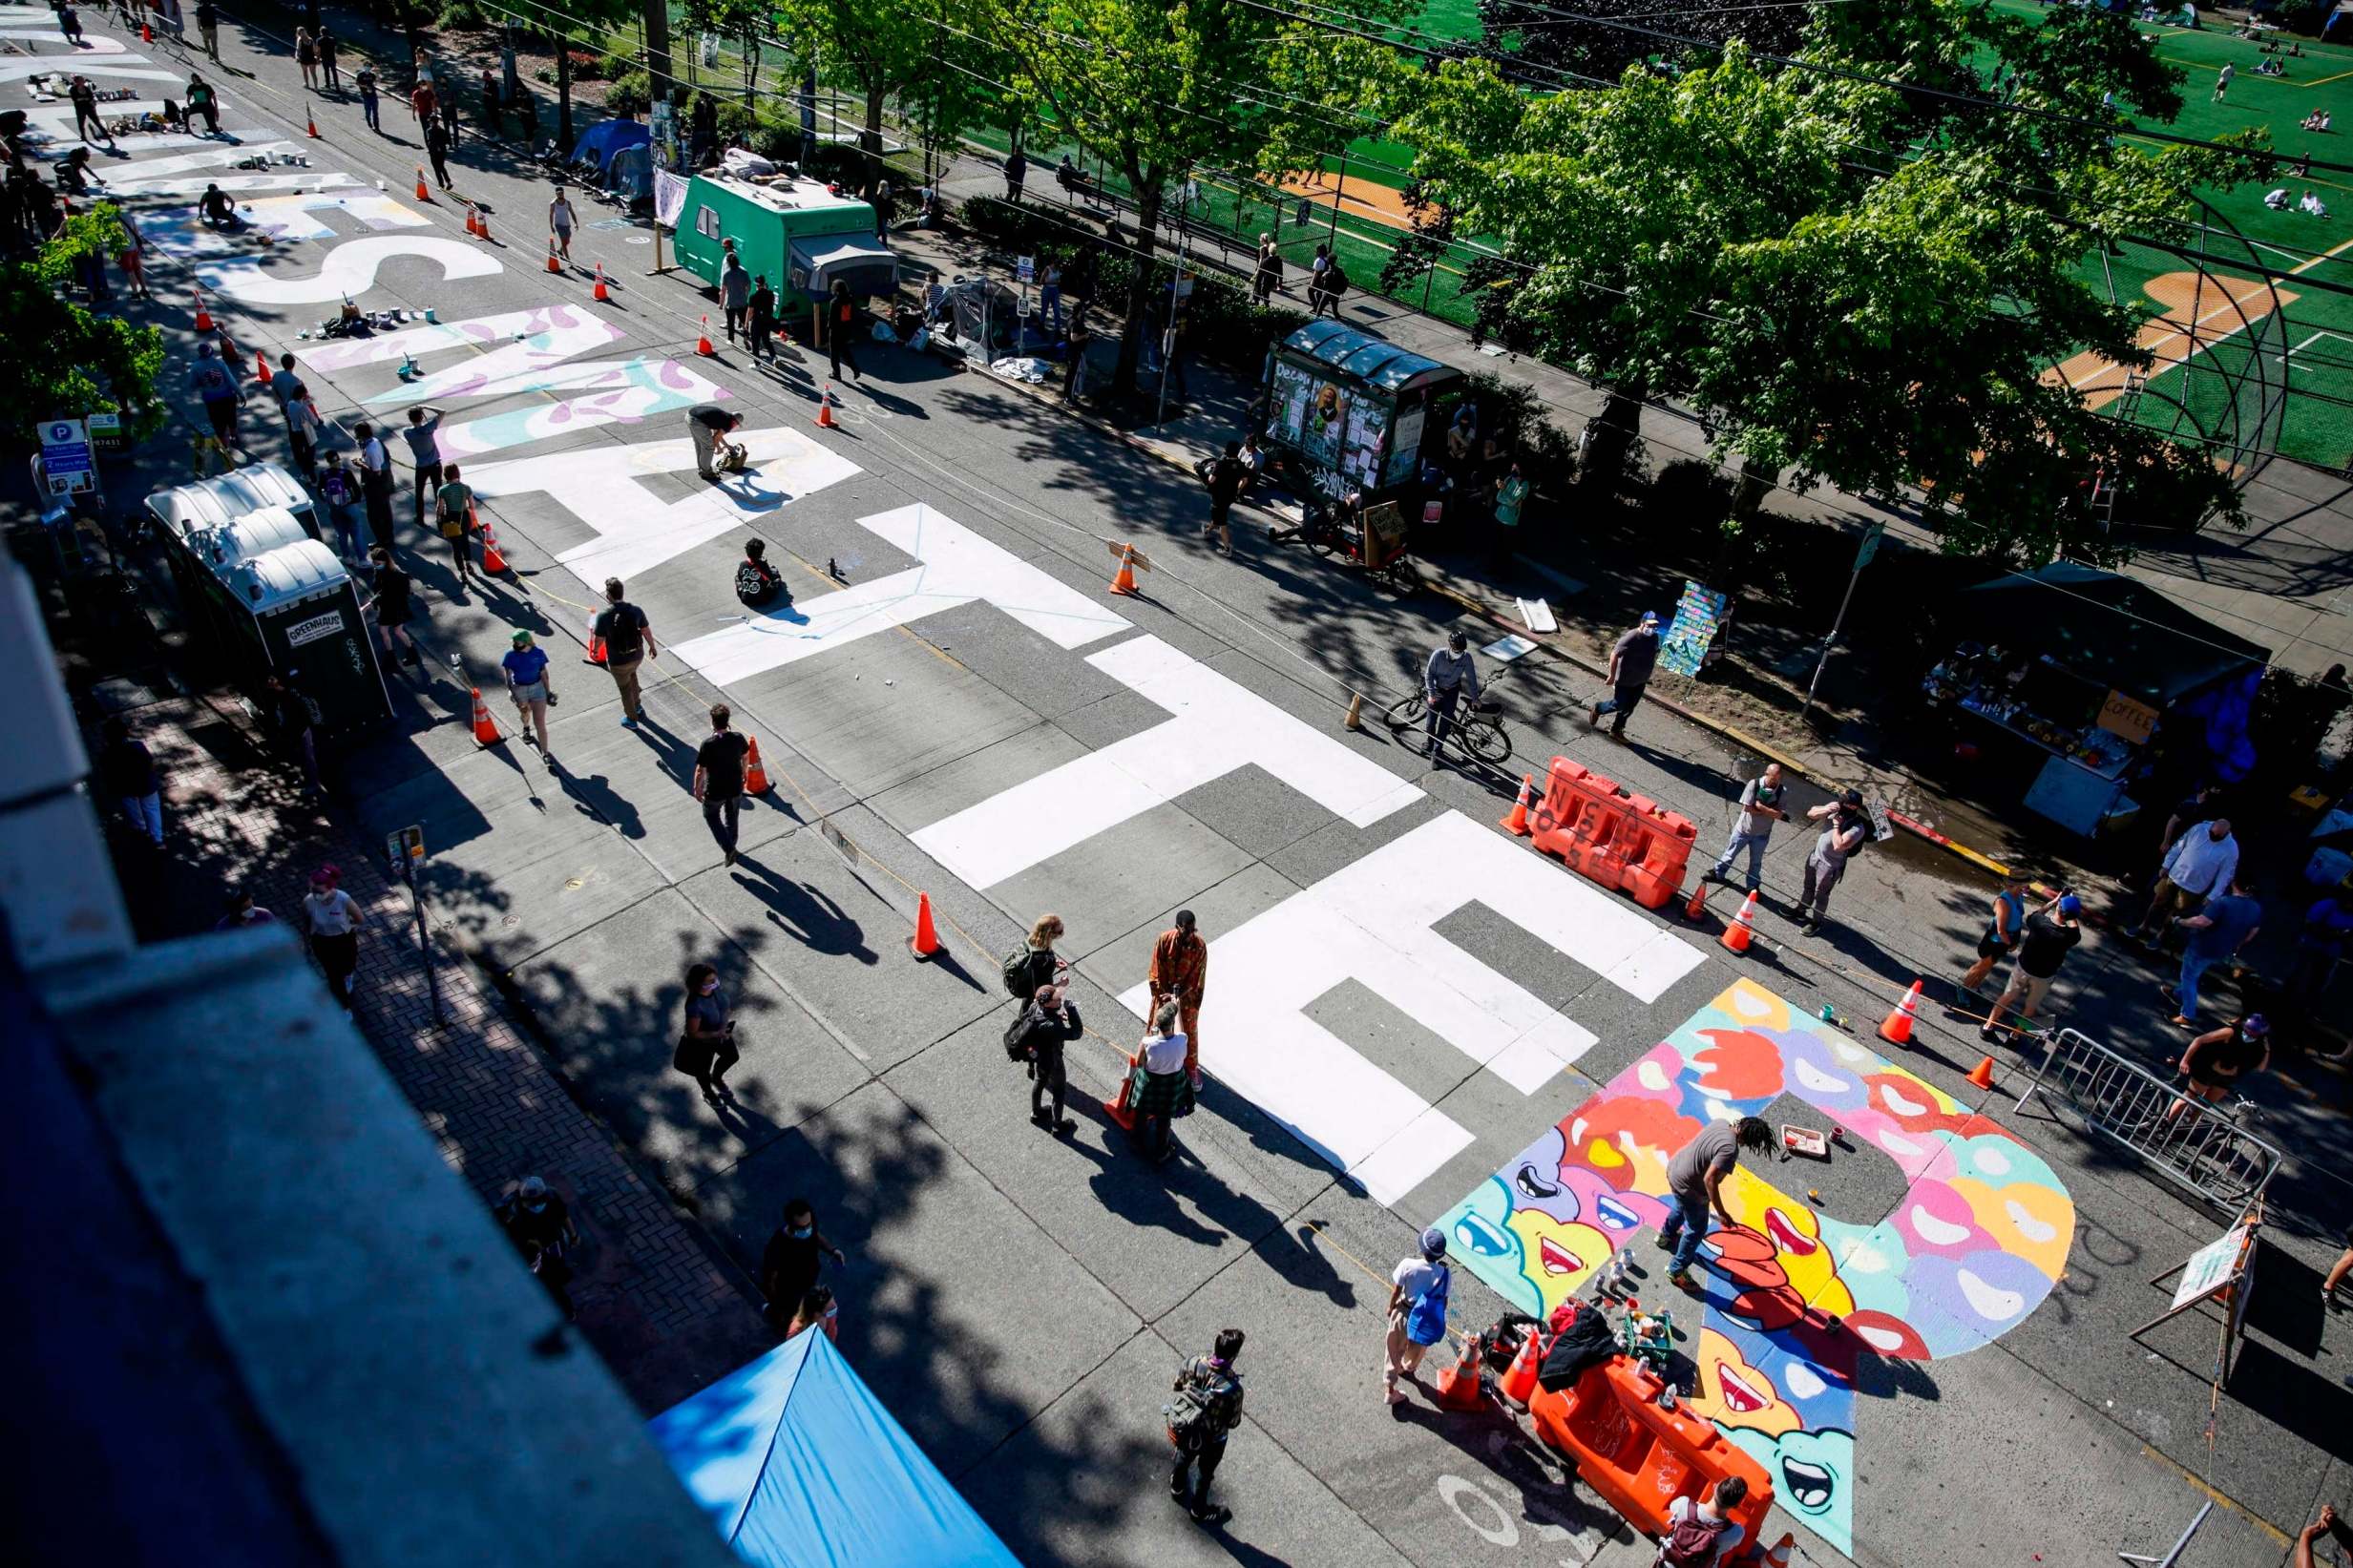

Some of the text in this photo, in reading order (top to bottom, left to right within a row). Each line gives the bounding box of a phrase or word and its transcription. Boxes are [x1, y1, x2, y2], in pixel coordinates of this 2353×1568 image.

[55, 427, 68, 439] P
[46, 460, 54, 469] 2
[289, 615, 340, 640] GREENHAUS
[2104, 699, 2154, 731] COFFEE
